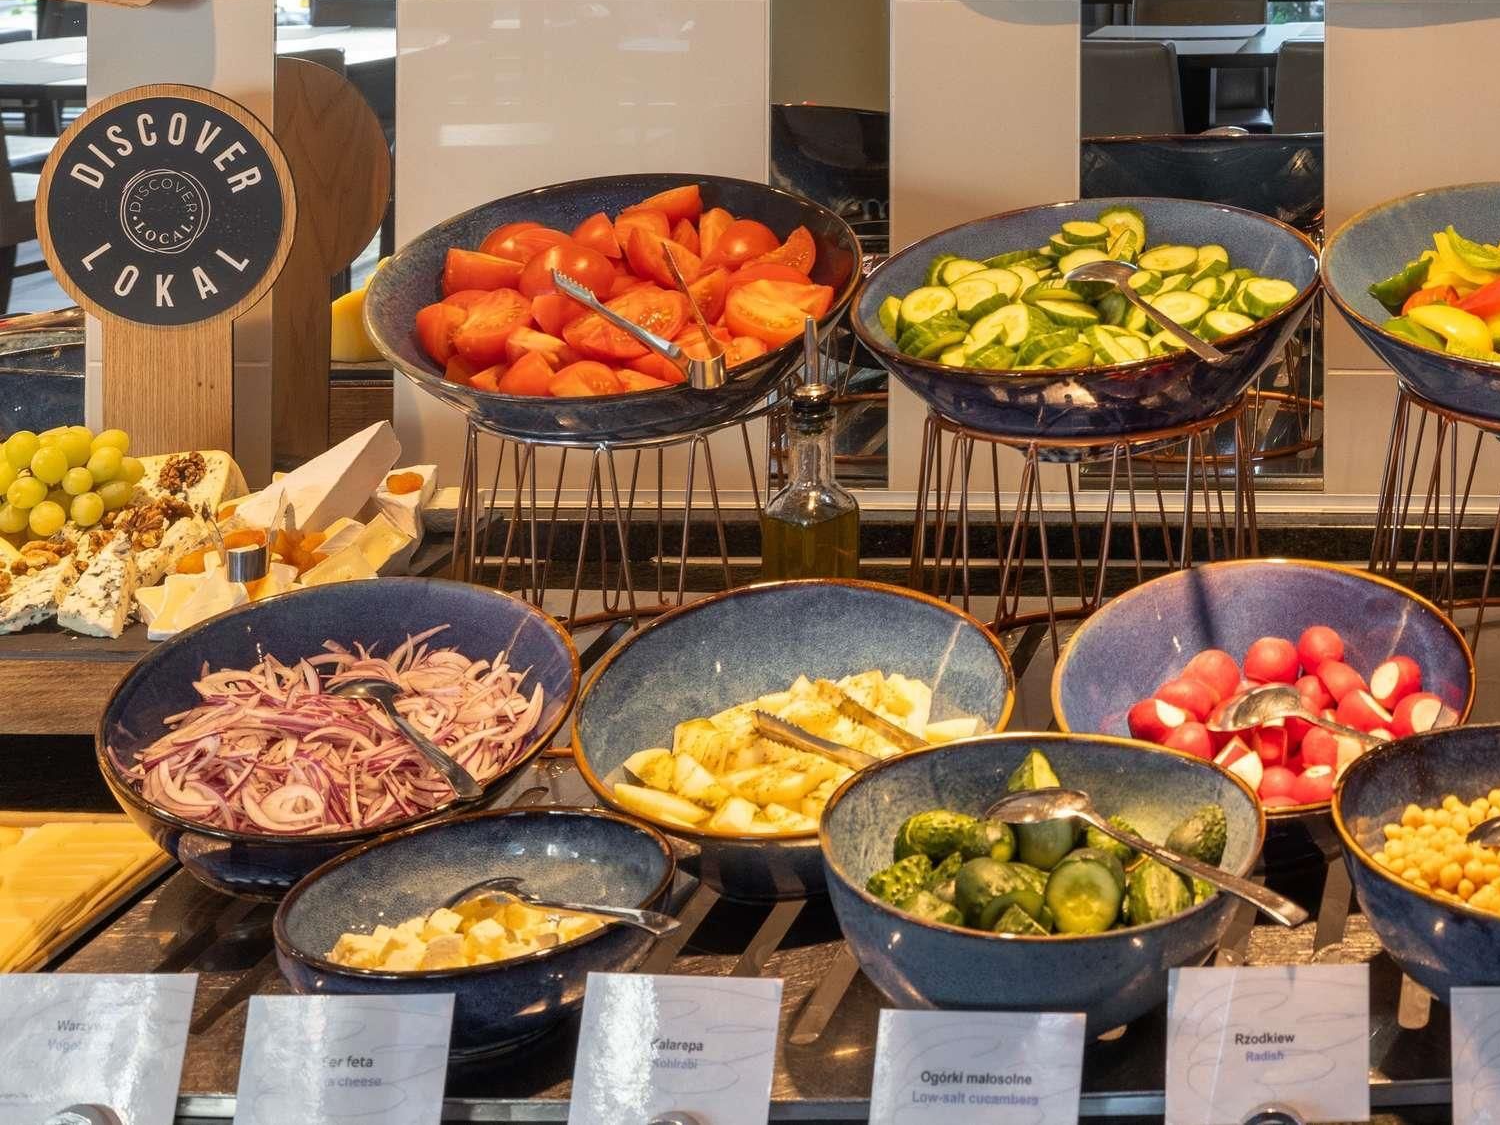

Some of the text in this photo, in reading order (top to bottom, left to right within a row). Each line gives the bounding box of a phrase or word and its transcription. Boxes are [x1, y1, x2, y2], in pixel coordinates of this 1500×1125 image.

[70, 112, 262, 194] DISCOVER
[129, 178, 198, 213] DISCOVER
[134, 221, 194, 244] LOCAL
[81, 242, 250, 307] LOKAL
[1234, 1032, 1296, 1046] Rzodkiew
[346, 1055, 374, 1068] feta
[1245, 1050, 1285, 1063] Radish
[920, 1069, 963, 1086] Ogórki
